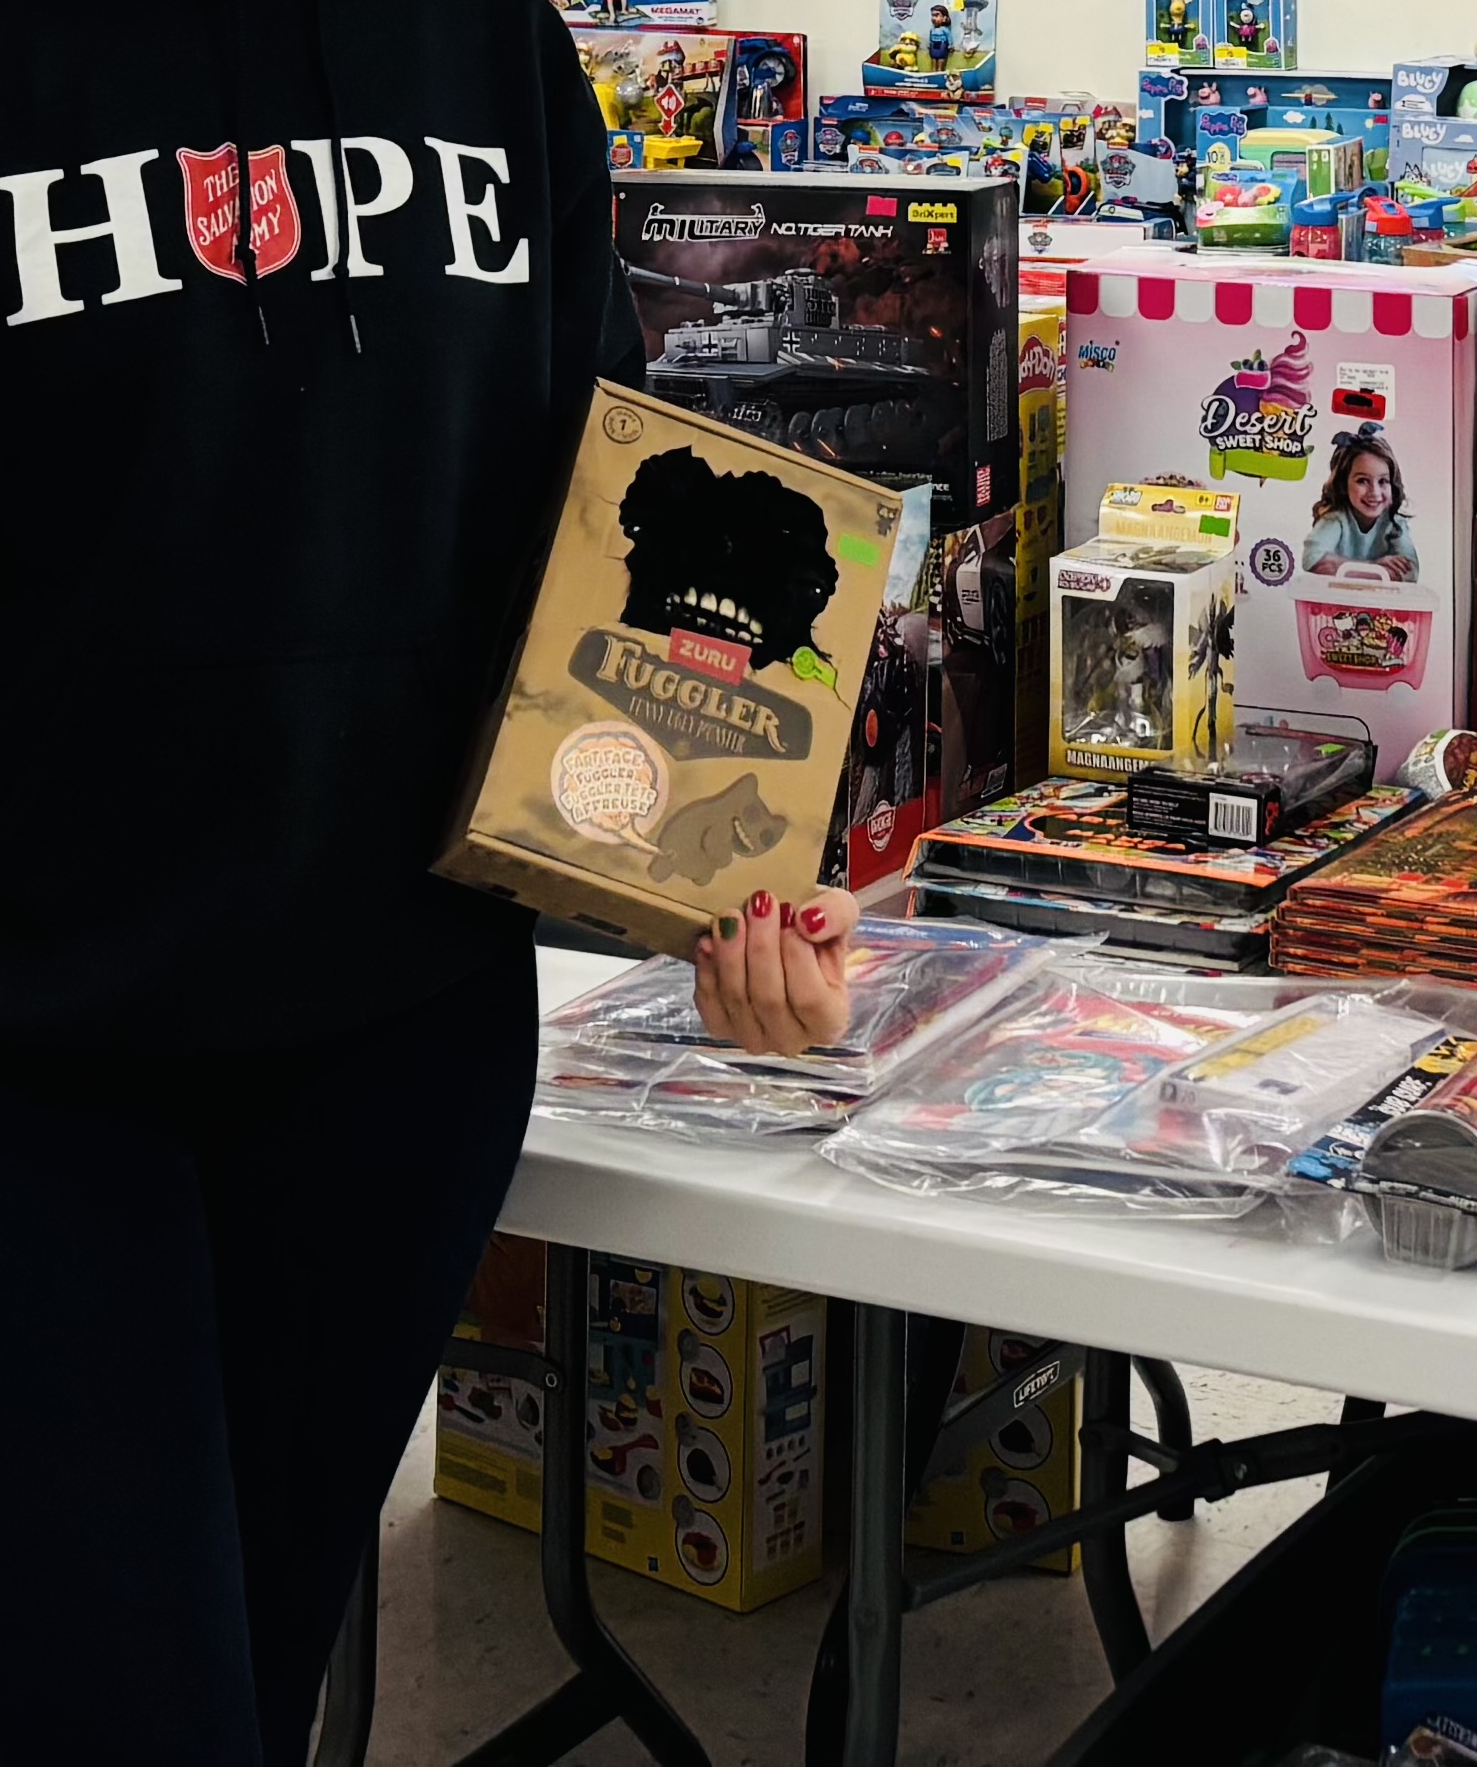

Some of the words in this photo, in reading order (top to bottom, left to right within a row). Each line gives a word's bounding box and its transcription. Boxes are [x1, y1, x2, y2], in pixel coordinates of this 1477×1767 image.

[203, 162, 240, 203] THE
[1199, 395, 1318, 437] Desert
[1215, 434, 1262, 450] SWEET
[1265, 435, 1302, 454] SHOP
[1263, 548, 1282, 563] 36
[1261, 563, 1284, 575] PCS
[678, 638, 737, 672] ZURU
[596, 634, 787, 754] FUGGLER
[601, 749, 646, 768] FACE
[575, 766, 635, 786] FUGGLER
[572, 795, 651, 823] AFFREUSE
